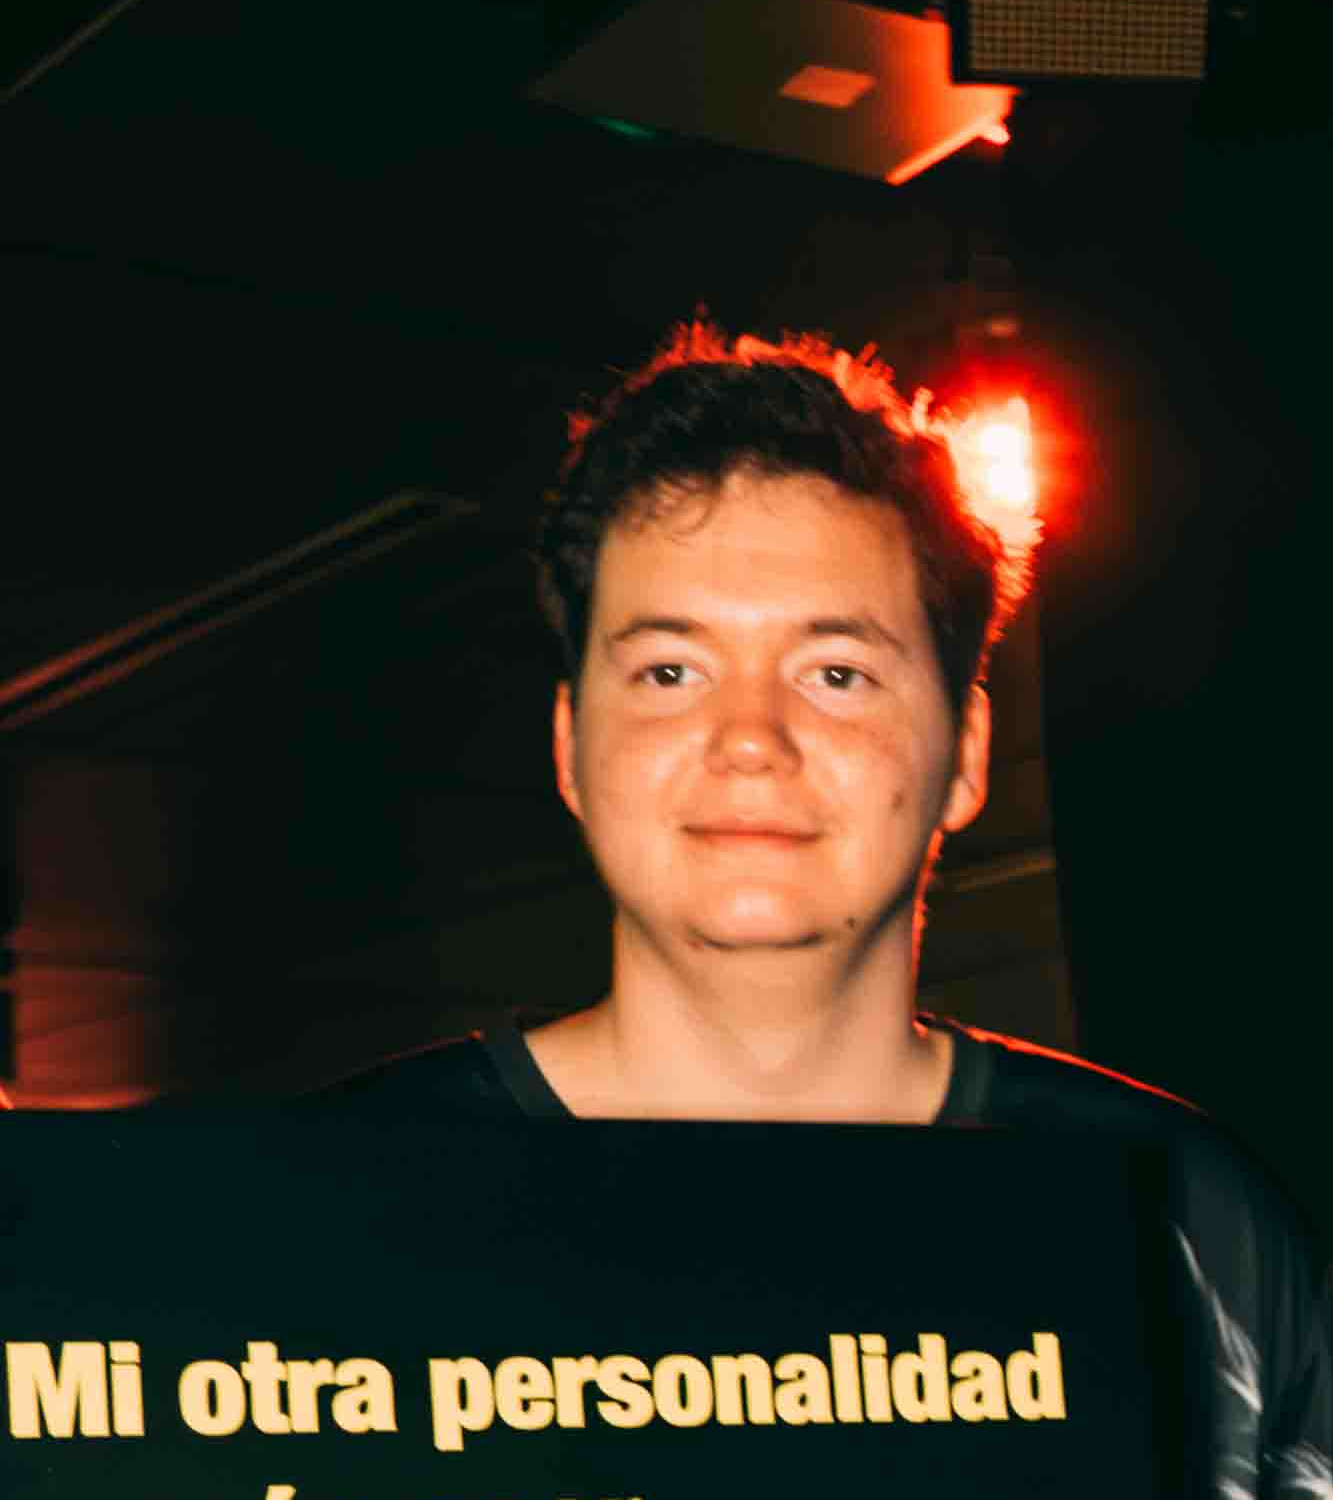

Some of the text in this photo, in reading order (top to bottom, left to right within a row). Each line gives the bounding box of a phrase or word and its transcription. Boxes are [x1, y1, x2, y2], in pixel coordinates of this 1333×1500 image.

[5, 1331, 1067, 1452] Mi otra personalidad
